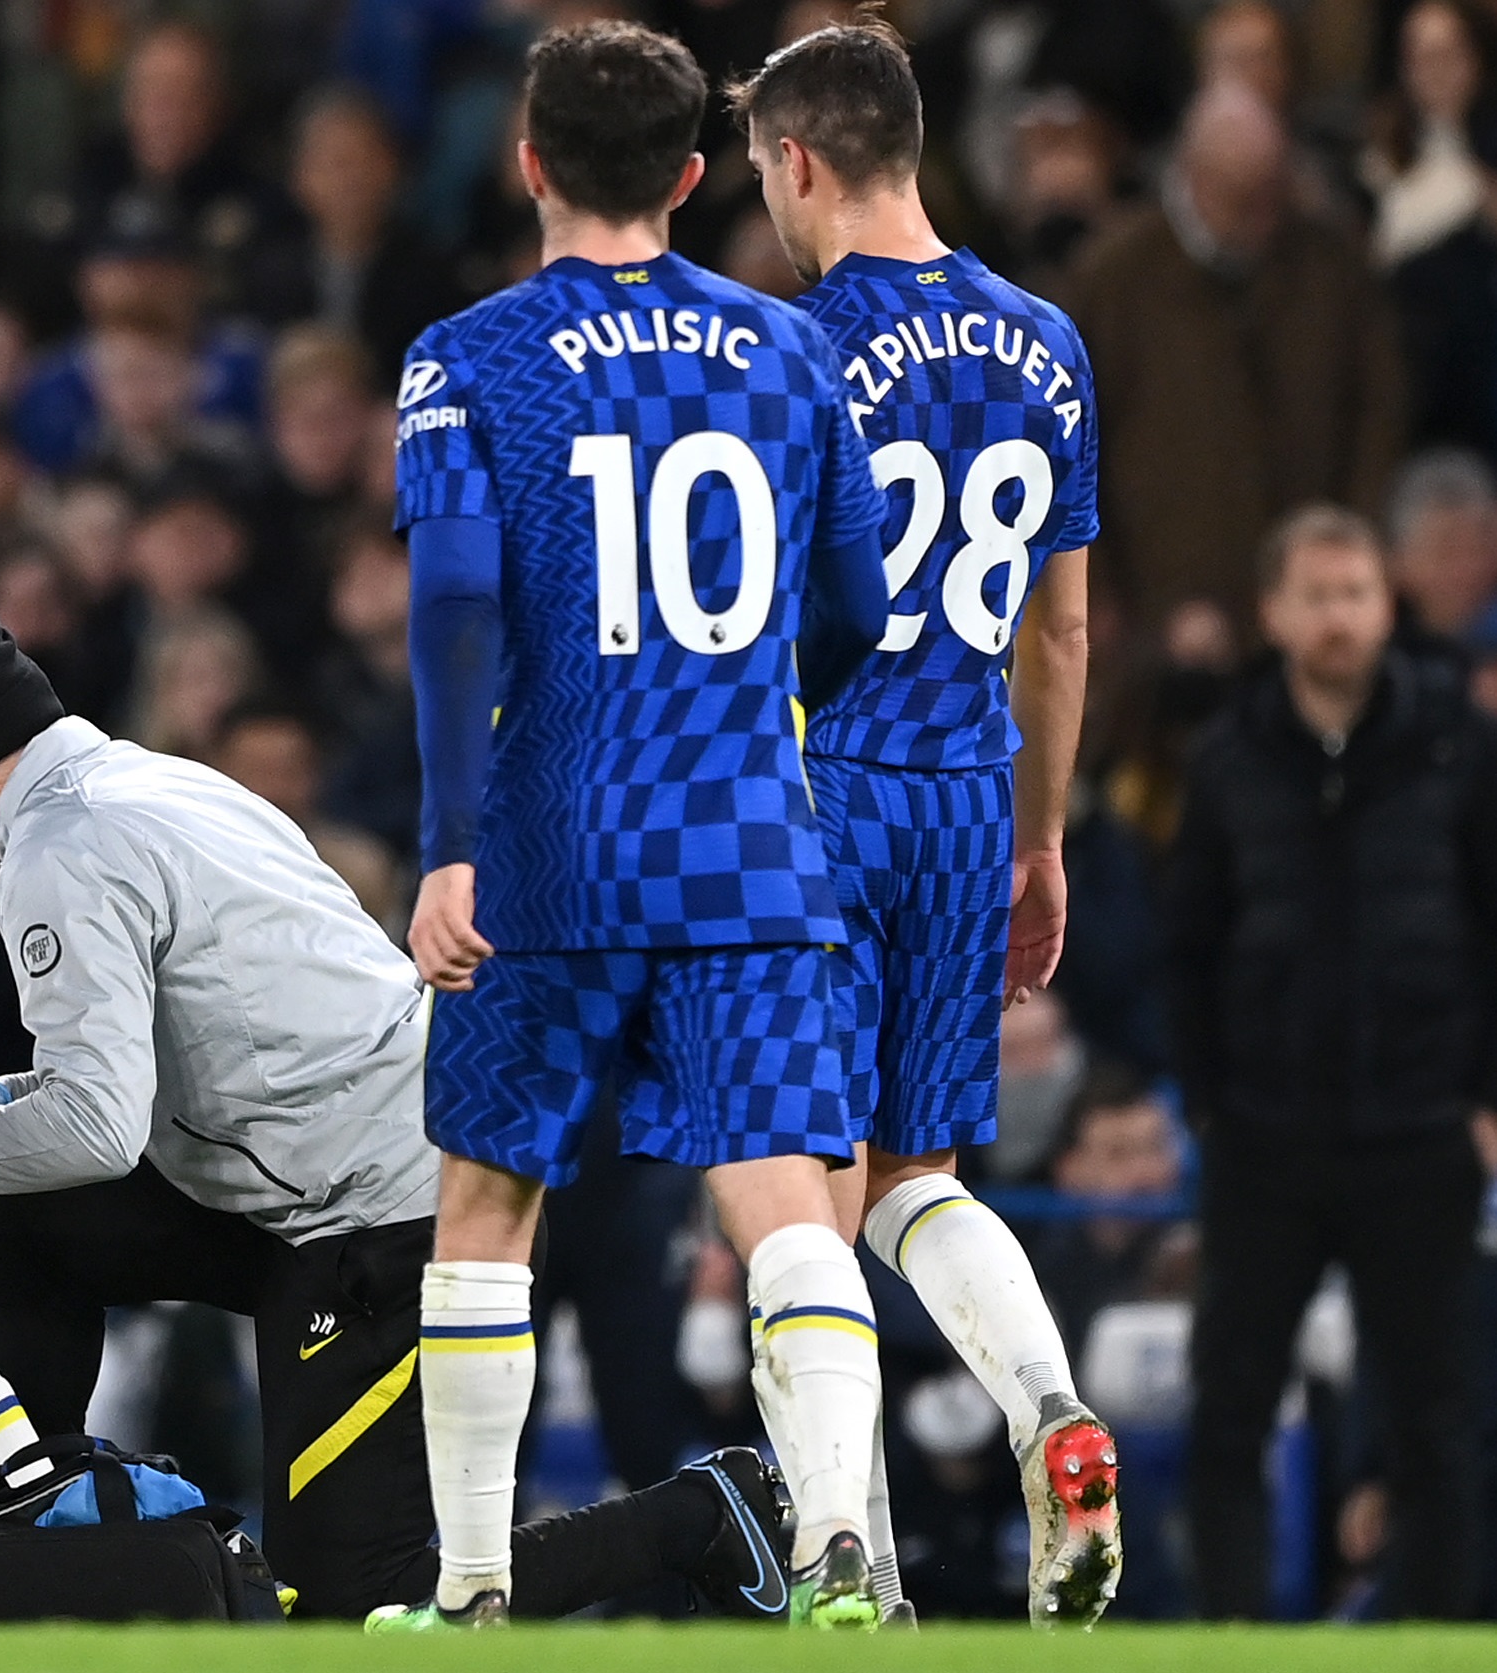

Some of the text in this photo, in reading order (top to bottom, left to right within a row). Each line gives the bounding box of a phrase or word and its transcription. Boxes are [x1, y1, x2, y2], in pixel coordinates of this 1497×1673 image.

[915, 270, 948, 285] CFC
[548, 308, 760, 374] PULISIC
[568, 431, 777, 656] 10
[868, 438, 1054, 656] 28
[310, 1311, 335, 1335] JH
